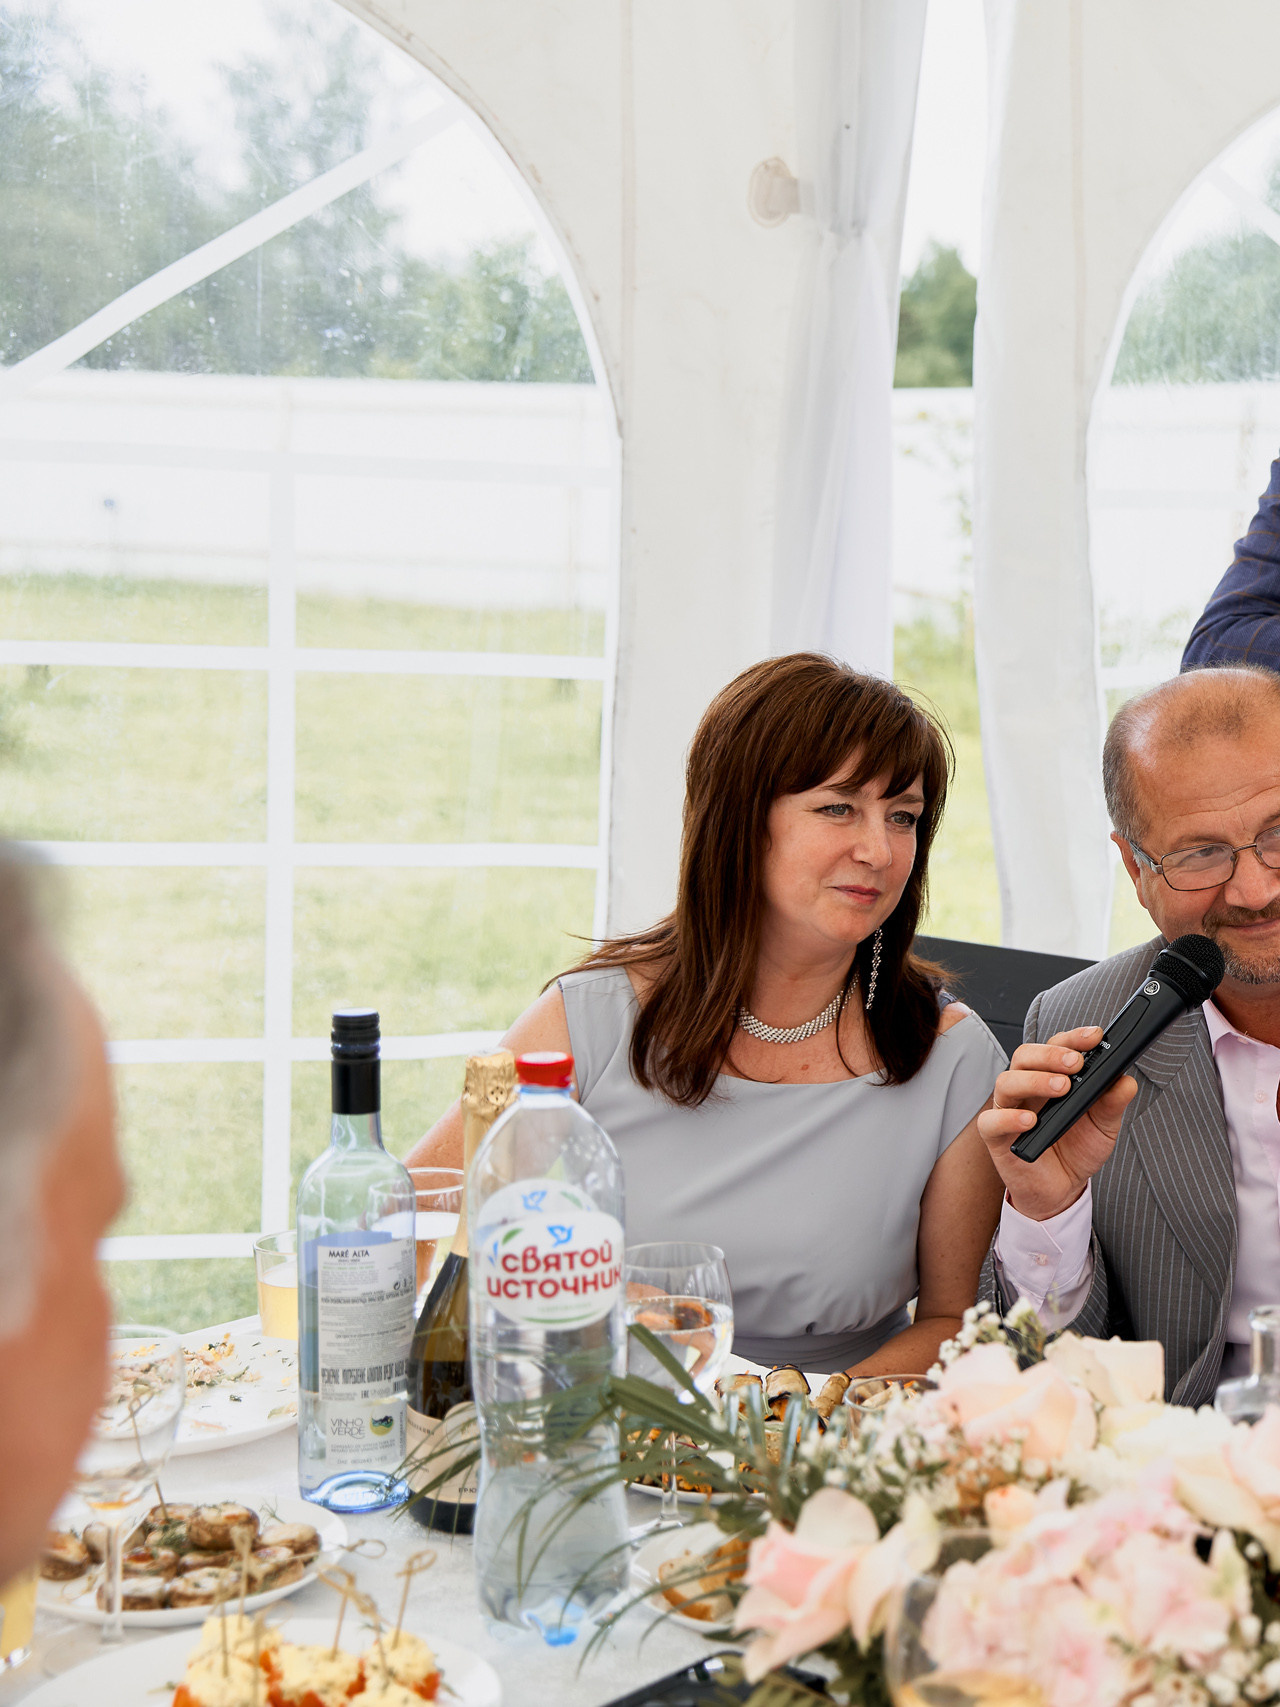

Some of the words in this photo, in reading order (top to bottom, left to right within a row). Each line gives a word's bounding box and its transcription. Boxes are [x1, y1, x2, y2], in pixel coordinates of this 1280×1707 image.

[328, 1249, 349, 1258] MARÉ
[352, 1249, 370, 1258] ALTA
[330, 1417, 363, 1427] VINHO
[330, 1426, 365, 1440] VERDE
